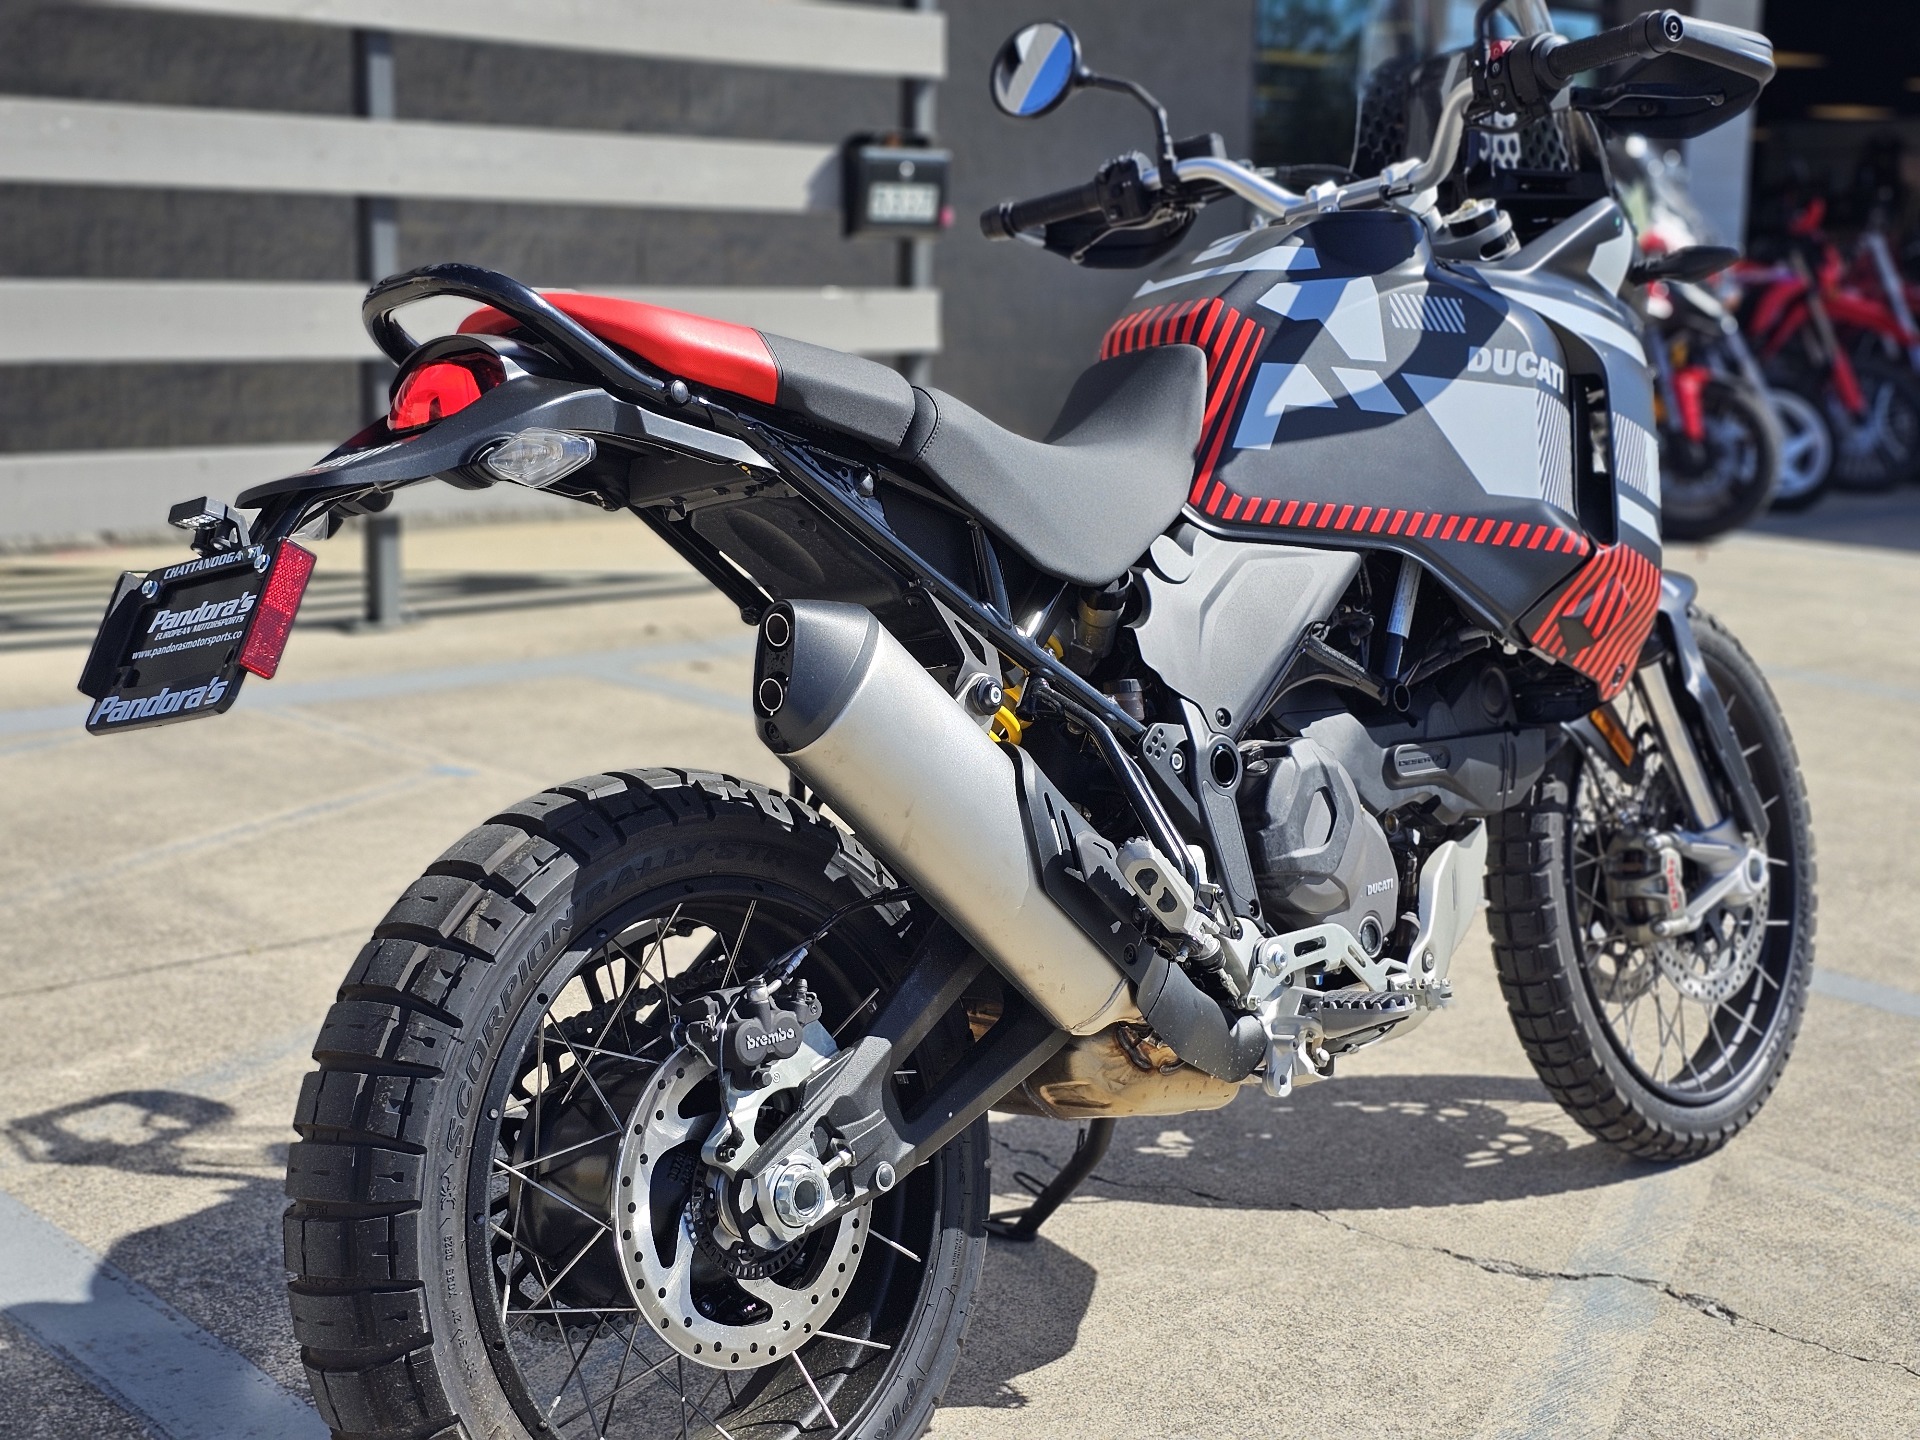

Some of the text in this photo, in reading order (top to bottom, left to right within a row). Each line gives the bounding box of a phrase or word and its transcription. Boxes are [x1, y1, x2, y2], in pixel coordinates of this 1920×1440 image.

[1467, 346, 1564, 394] DUCATI
[163, 550, 243, 580] CHATTANOOGA
[147, 591, 257, 633] Pandora's
[154, 614, 246, 641] EUROPEAN MOTORSPORTS
[89, 676, 229, 725] Pandora's
[1367, 878, 1394, 896] DUCATI
[448, 902, 577, 1158] SCORPION
[746, 1027, 795, 1050] brembo
